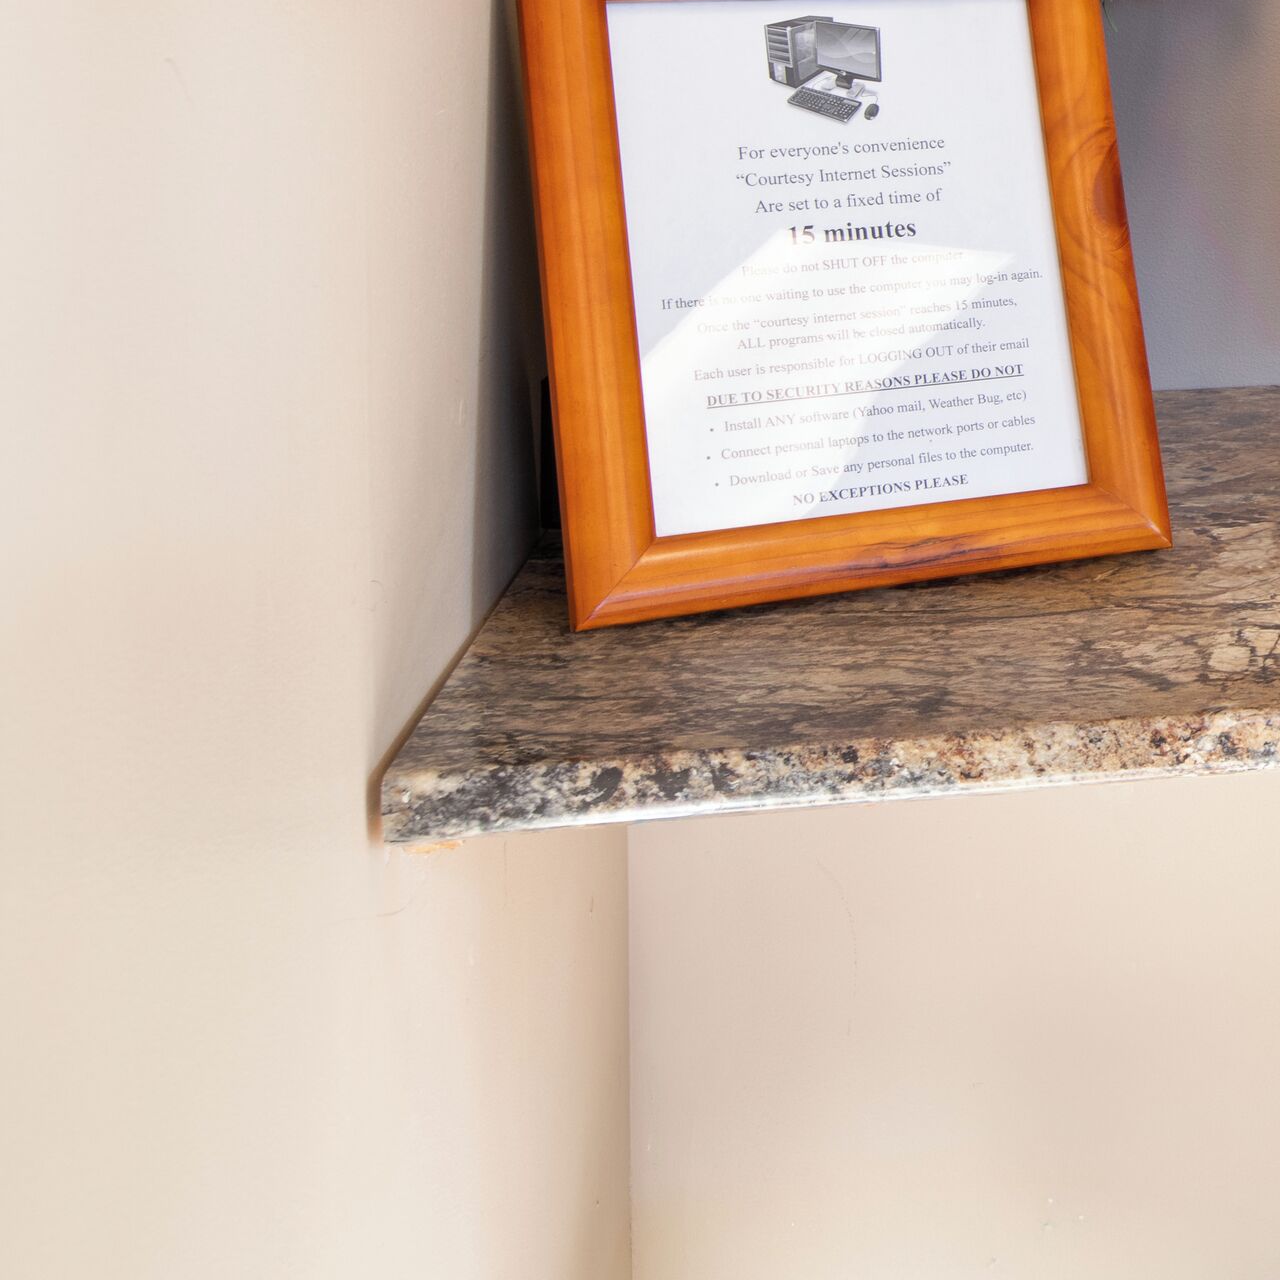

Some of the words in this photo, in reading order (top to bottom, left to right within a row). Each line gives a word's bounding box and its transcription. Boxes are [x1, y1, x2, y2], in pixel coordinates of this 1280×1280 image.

[738, 146, 765, 160] For
[770, 142, 849, 161] everyone's
[854, 137, 945, 155] convenience
[735, 172, 813, 189] “Courtesy
[820, 167, 876, 182] Internet
[881, 162, 951, 178] Sessions”
[755, 200, 783, 214] Are
[788, 199, 810, 211] set
[815, 198, 829, 210] to
[833, 199, 842, 209] a
[846, 193, 884, 207] fixed
[888, 190, 920, 204] time
[925, 188, 942, 202] of
[789, 225, 815, 245] 15
[824, 219, 917, 243] minutes
[783, 265, 797, 273] do
[801, 263, 819, 272] not
[822, 258, 858, 270] SHUT
[862, 256, 887, 267] OFF
[891, 254, 907, 265] the
[662, 299, 672, 310] If
[675, 298, 704, 309] there
[766, 290, 808, 303] waiting
[813, 289, 824, 297] to
[828, 288, 846, 296] use
[850, 284, 866, 294] the
[870, 281, 921, 293] computer
[925, 279, 946, 290] you
[949, 277, 972, 288] may
[977, 272, 1008, 283] log-in
[1011, 269, 1043, 282] again.
[697, 323, 728, 334] Once
[733, 320, 750, 331] the
[754, 316, 809, 329] “courtesy
[814, 312, 856, 324] internet
[860, 306, 906, 319] session”
[910, 302, 951, 315] reaches
[956, 300, 968, 311] 15
[972, 297, 1017, 310] minutes,
[737, 339, 766, 350] ALL
[769, 335, 823, 349] programs
[826, 330, 849, 341] will
[853, 326, 866, 338] be
[869, 326, 905, 337] closed
[909, 317, 986, 335] automatically.
[694, 369, 724, 380] Each
[728, 367, 751, 377] user
[755, 365, 766, 375] is
[769, 358, 835, 375] responsible
[839, 354, 854, 366] for
[859, 349, 922, 365] LOGGING
[925, 346, 953, 358] OUT
[957, 344, 969, 354] of
[972, 341, 996, 353] their
[1000, 338, 1030, 350] email
[707, 393, 738, 407] DUE
[742, 391, 762, 402] TO
[766, 382, 841, 400] SECURITY
[845, 375, 910, 392] REASONS
[915, 370, 967, 385] PLEASE
[971, 367, 991, 379] DO
[995, 364, 1023, 376] NOT
[725, 418, 761, 431] Install
[765, 414, 796, 428] ANY
[799, 411, 849, 423] software
[853, 405, 894, 419] (Yahoo
[897, 401, 925, 412] mail,
[929, 394, 974, 409] Weather
[977, 393, 1003, 405] Bug,
[1006, 390, 1027, 401] etc)
[721, 446, 770, 460] Connect
[775, 438, 824, 455] personal
[828, 434, 869, 448] laptops
[873, 433, 884, 442] to
[887, 430, 904, 441] the
[908, 424, 953, 438] network
[957, 422, 984, 435] ports
[987, 421, 998, 429] or
[1002, 415, 1036, 427] cables
[730, 470, 792, 486] Download
[795, 468, 808, 478] or
[811, 464, 840, 476] Save
[843, 463, 864, 474] any
[868, 455, 914, 472] personal
[918, 452, 942, 464] files
[946, 451, 957, 461] to
[960, 448, 977, 459] the
[980, 442, 1033, 458] computer.
[793, 492, 815, 505] NO
[819, 481, 911, 502] EXCEPTIONS
[915, 474, 969, 490] PLEASE
